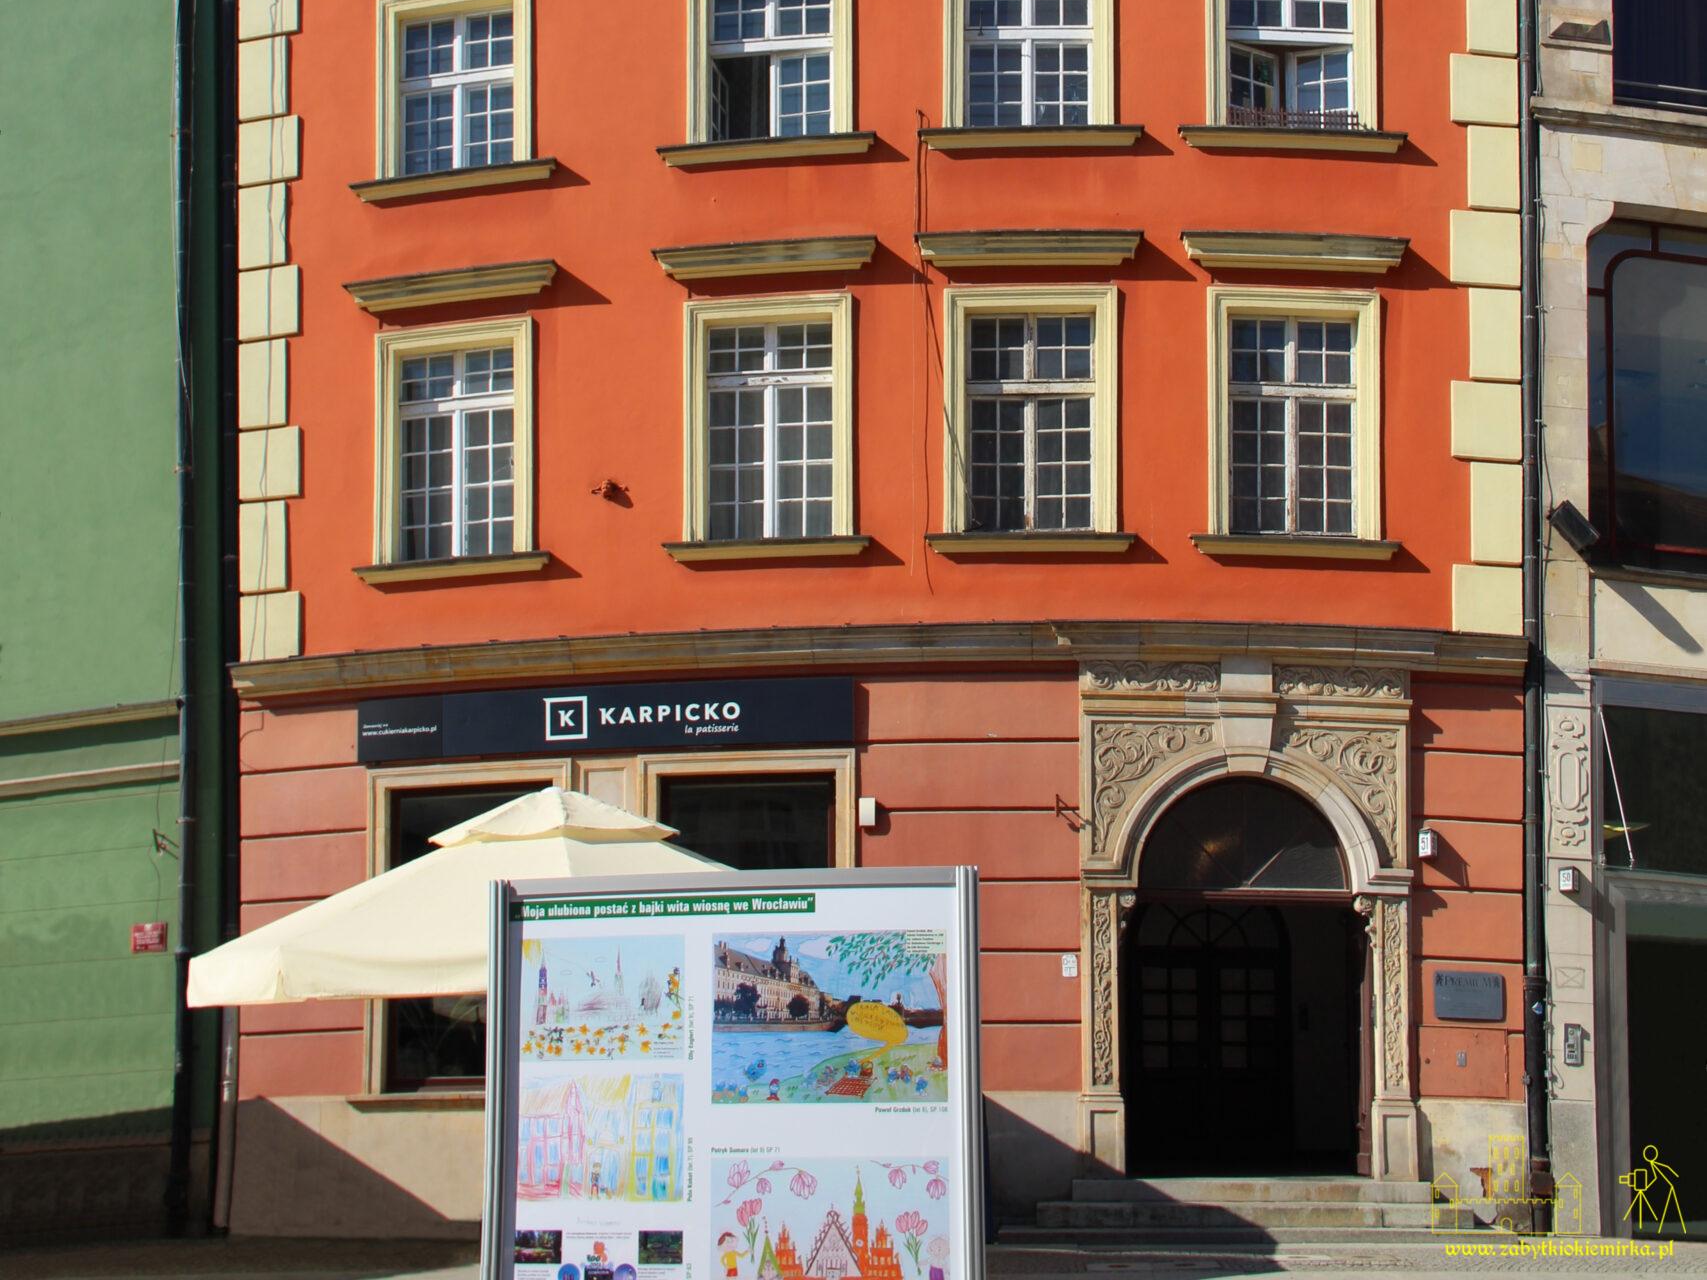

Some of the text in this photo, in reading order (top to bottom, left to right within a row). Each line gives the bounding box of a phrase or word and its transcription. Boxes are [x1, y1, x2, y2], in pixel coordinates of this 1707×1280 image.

[558, 709, 575, 728] K
[599, 701, 741, 726] KARPICKO
[362, 725, 437, 736] www.cukierniakarpicko.pl
[685, 723, 739, 736] la patisserie
[1421, 837, 1429, 851] 51
[1562, 872, 1570, 882] 50
[548, 904, 591, 916] ulubiona
[594, 902, 628, 917] postać
[631, 905, 636, 913] z
[639, 901, 664, 915] bajki
[667, 900, 689, 912] wita
[693, 899, 730, 913] wiosnę
[733, 901, 749, 910] we
